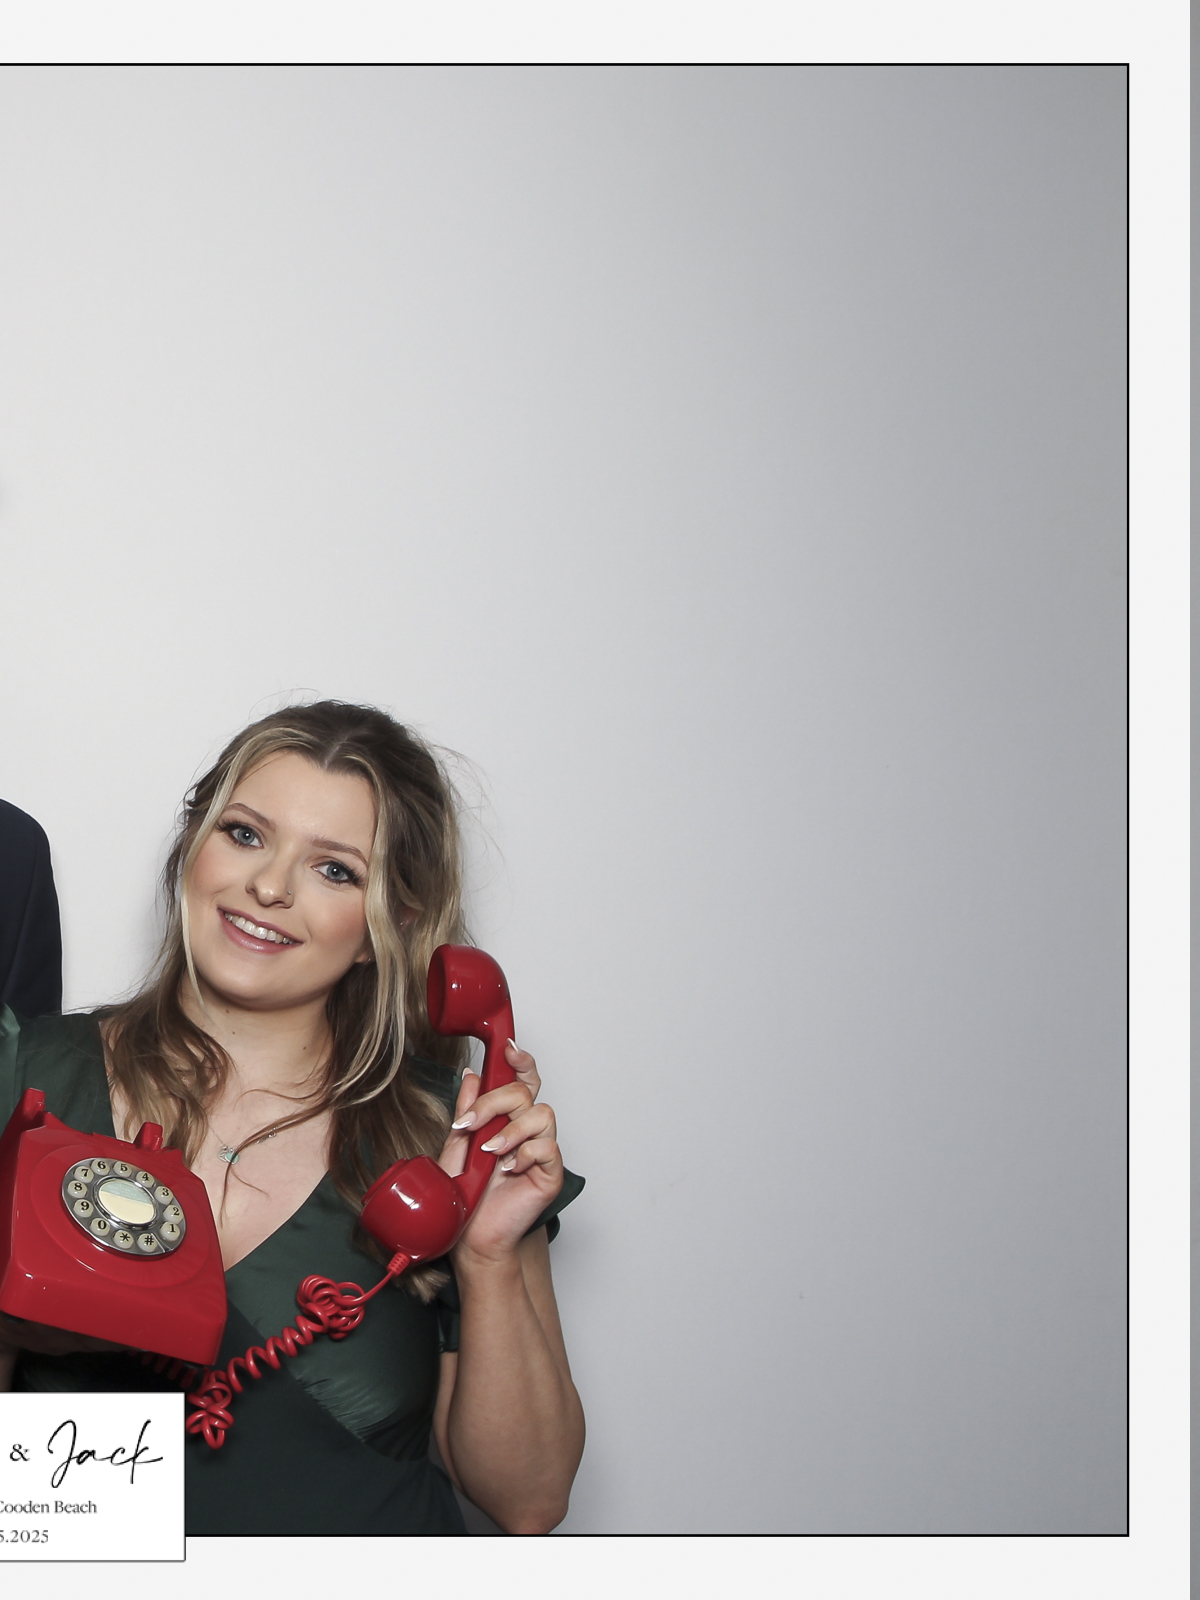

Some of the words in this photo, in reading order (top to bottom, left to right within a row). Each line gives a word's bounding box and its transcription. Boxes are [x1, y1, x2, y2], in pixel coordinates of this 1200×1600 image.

[97, 1161, 106, 1170] 6
[120, 1163, 128, 1172] 5
[81, 1168, 89, 1177] 7
[142, 1173, 149, 1181] 4
[74, 1182, 83, 1191] 8
[162, 1187, 170, 1197] 3
[80, 1201, 90, 1211] 9
[172, 1207, 180, 1216] 2
[97, 1220, 107, 1230] 0
[169, 1224, 176, 1233] 1
[144, 1235, 154, 1246] #
